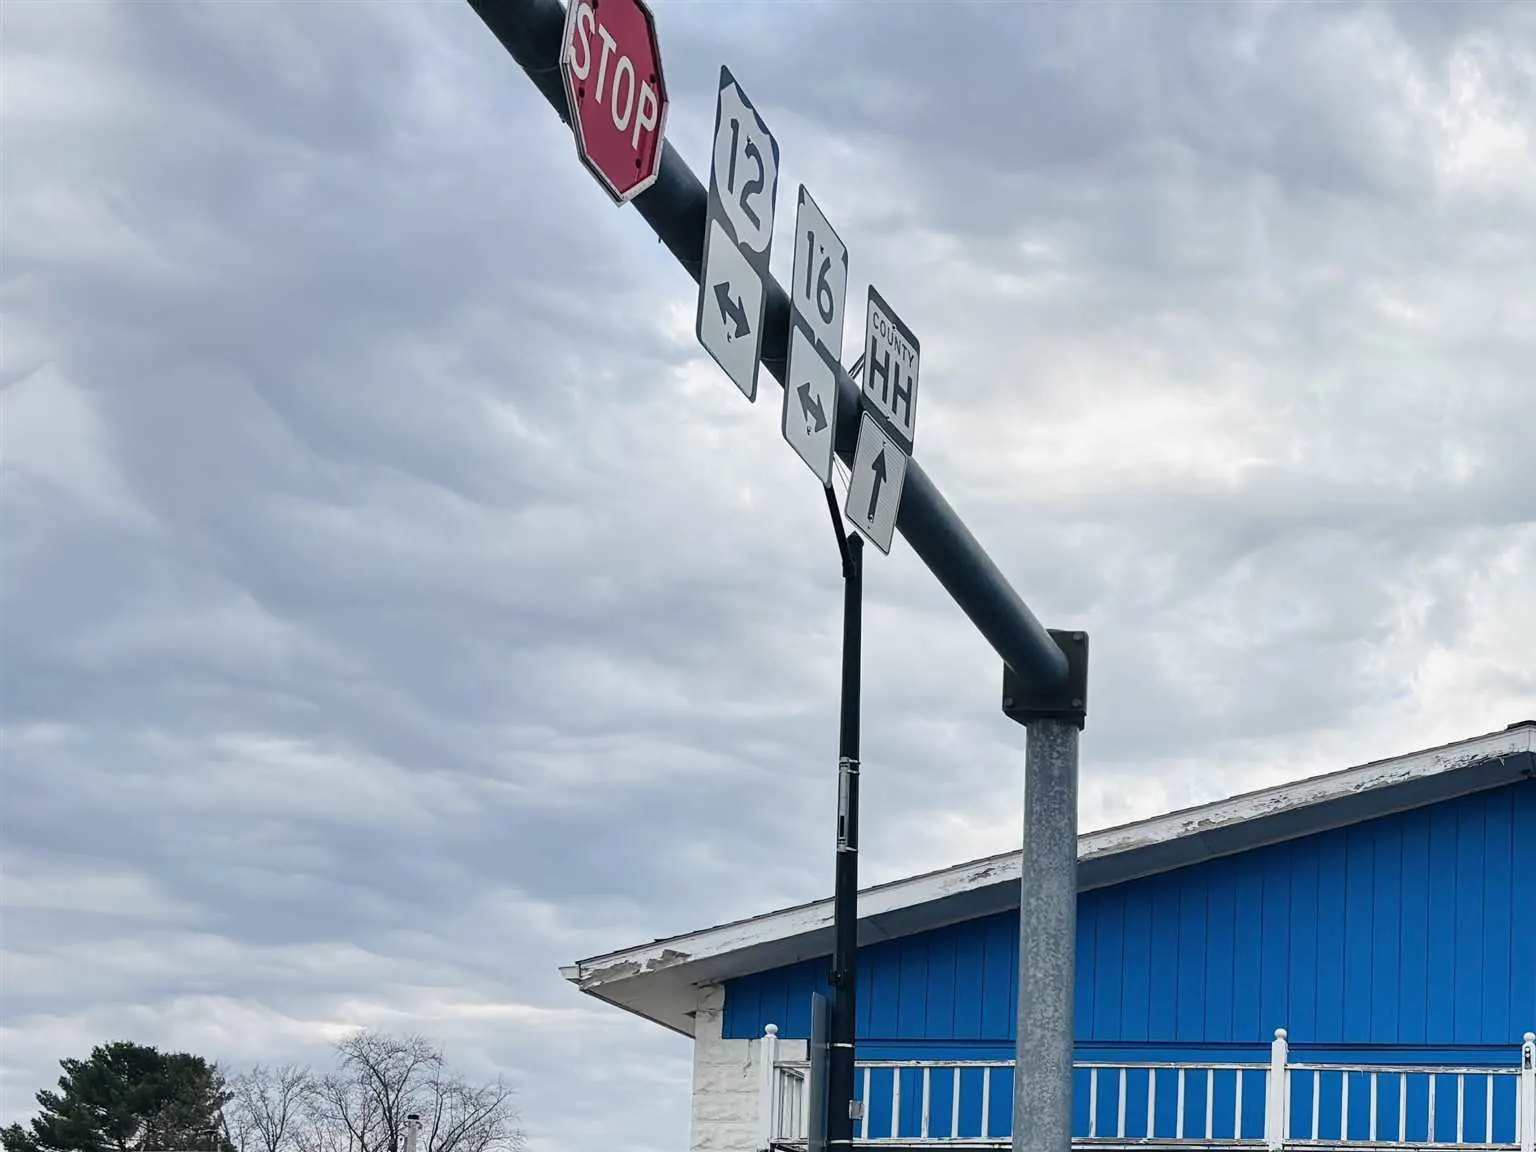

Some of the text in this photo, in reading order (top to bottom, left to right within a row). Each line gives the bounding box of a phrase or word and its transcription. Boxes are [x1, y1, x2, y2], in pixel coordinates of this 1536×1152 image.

[570, 2, 658, 151] STOP
[728, 118, 765, 232] 12
[805, 231, 834, 325] 16
[869, 335, 912, 428] HH
[872, 311, 915, 369] COUNTY
